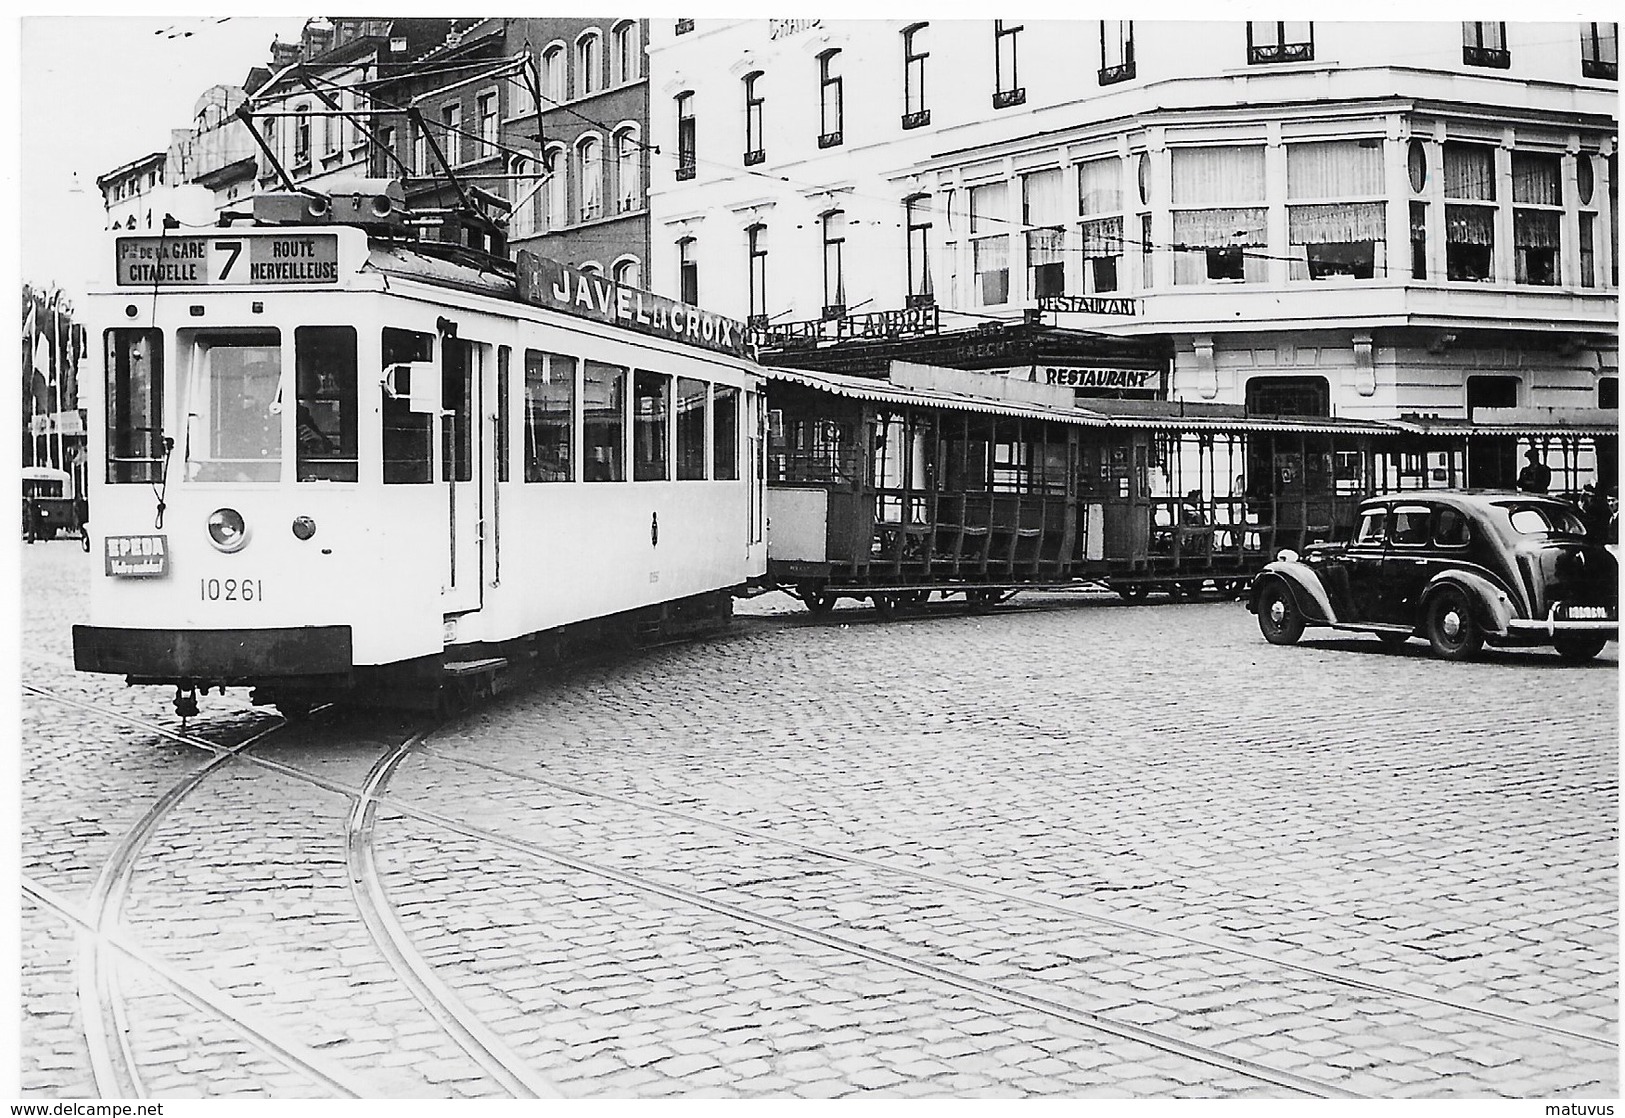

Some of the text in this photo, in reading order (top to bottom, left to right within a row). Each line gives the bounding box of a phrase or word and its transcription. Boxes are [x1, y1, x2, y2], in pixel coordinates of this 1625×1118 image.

[140, 247, 153, 260] DE
[155, 247, 170, 260] LA
[172, 241, 206, 259] GARE
[273, 240, 316, 259] ROUTE
[214, 241, 242, 281] 7
[250, 261, 339, 281] MERVEILLEUSE
[129, 263, 198, 282] CITADELLE
[552, 269, 734, 348] JAVEL LA CROIX
[1038, 296, 1137, 316] RESTAURANT
[1046, 369, 1149, 387] RESTAURANT
[108, 537, 164, 557] EPEDA
[201, 578, 262, 602] 10261
